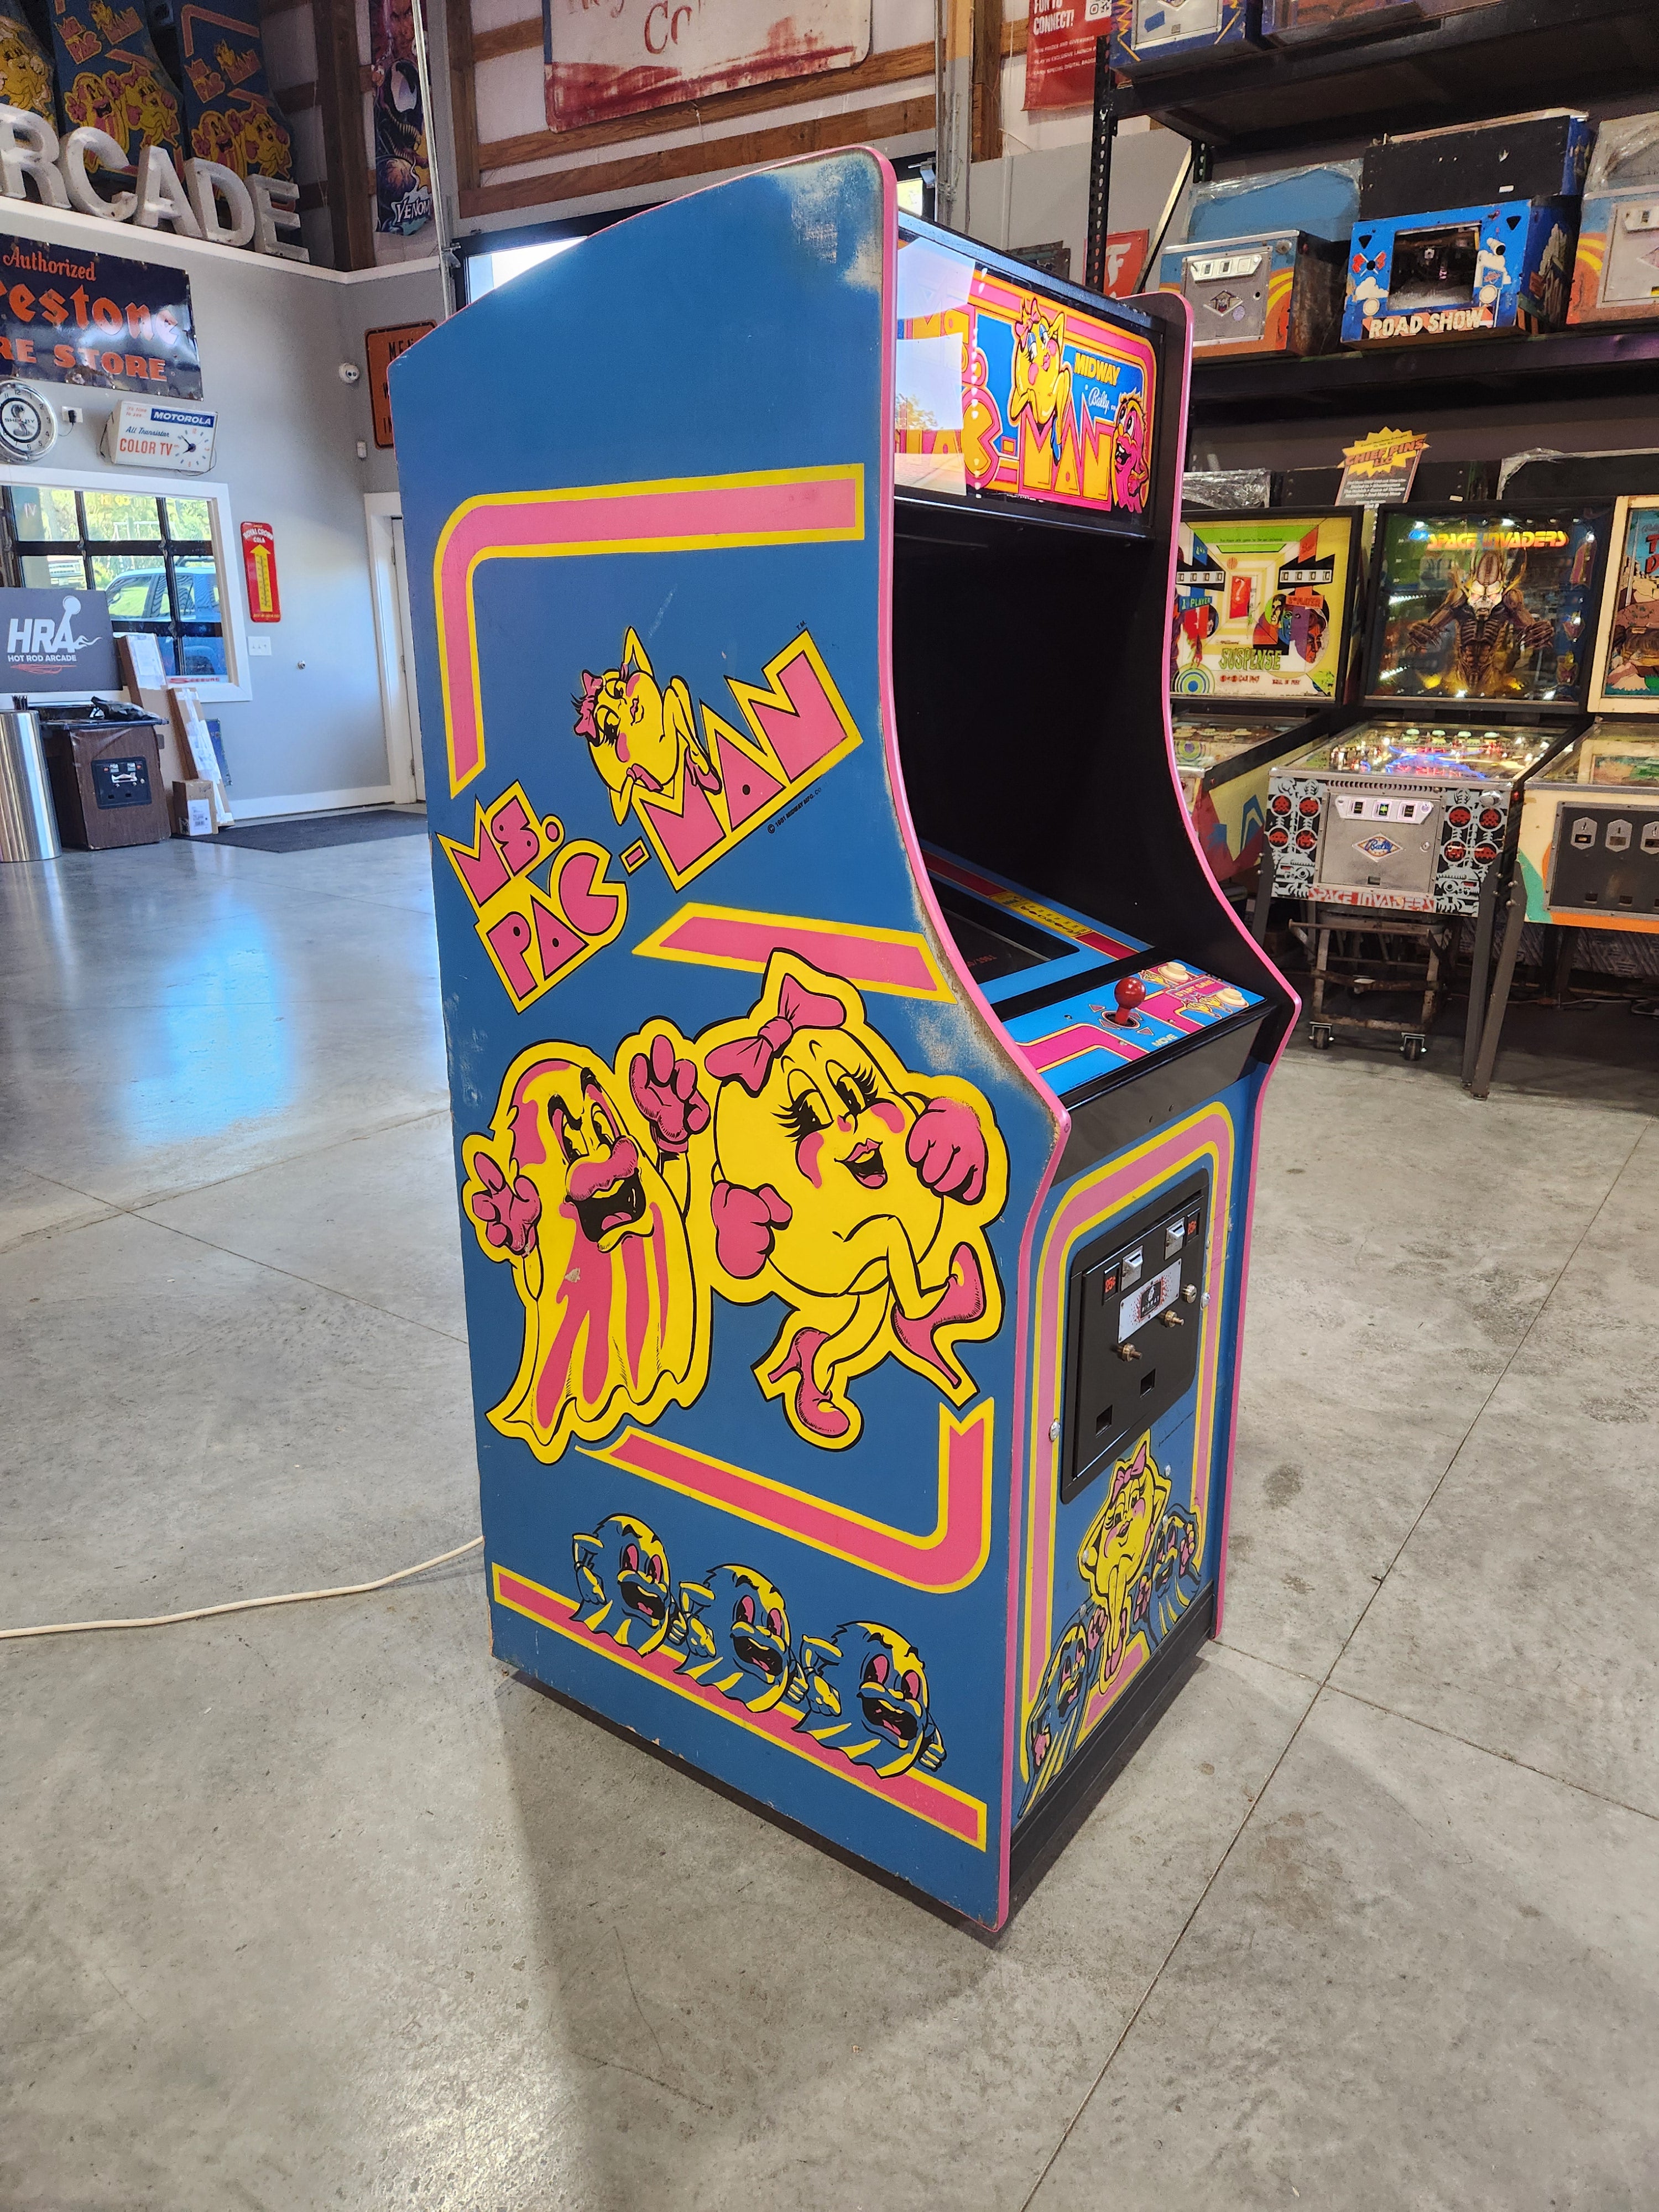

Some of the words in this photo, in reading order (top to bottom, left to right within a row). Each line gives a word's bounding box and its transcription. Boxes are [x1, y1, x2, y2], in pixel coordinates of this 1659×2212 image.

[1033, 9, 1074, 35] CONNECT!
[397, 198, 431, 222] VENOM
[3, 246, 97, 281] Authorized
[1369, 315, 1423, 339] ROAD
[1427, 309, 1484, 332] SHOW
[54, 344, 167, 382] STORE
[1073, 352, 1121, 387] MIDWAY
[154, 411, 212, 425] MOTOROLA
[119, 438, 156, 454] COLOR
[160, 442, 173, 456] TV
[1345, 447, 1387, 466] CHIEF
[1387, 439, 1425, 457] PINS
[1374, 455, 1394, 467] LLC
[243, 528, 258, 540] ROYAL
[258, 528, 274, 540] CROWN
[1427, 533, 1477, 549] SPACE
[1482, 530, 1569, 549] INVADERS
[1190, 597, 1211, 607] PLAYER
[7, 611, 79, 653] HRA
[1218, 647, 1282, 671] SUSPENSE
[775, 816, 786, 827] 1981
[786, 801, 804, 818] MIDWAY
[1364, 838, 1393, 853] Bally
[1308, 887, 1352, 904] SPACE
[1357, 891, 1435, 913] INVADERS
[1174, 985, 1198, 997] START
[1195, 979, 1215, 989] GAME
[1151, 1033, 1178, 1047] MOVE
